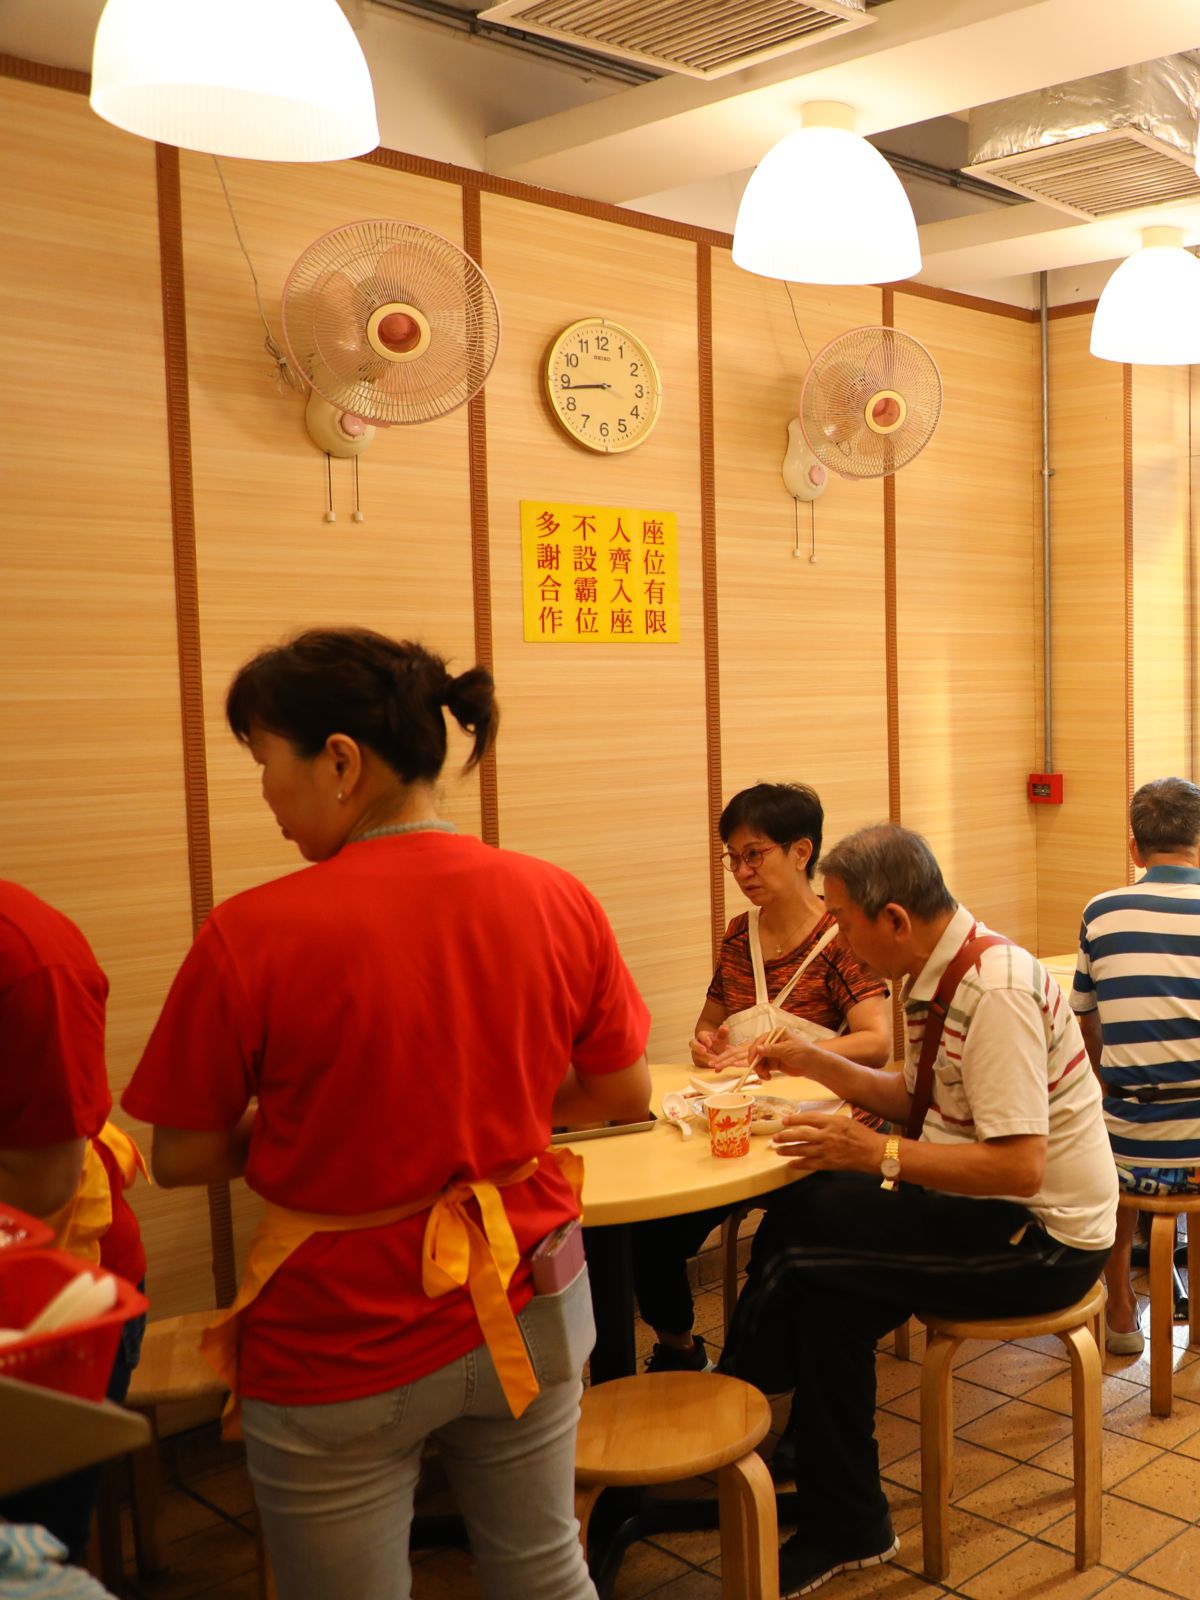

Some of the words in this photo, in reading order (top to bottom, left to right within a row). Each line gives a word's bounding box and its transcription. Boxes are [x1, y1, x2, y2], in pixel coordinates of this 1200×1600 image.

[578, 338, 589, 354] 11
[595, 335, 609, 351] 12
[564, 352, 579, 368] 10
[629, 362, 639, 377] 2
[560, 374, 571, 388] 9
[634, 384, 644, 399] 3
[566, 396, 576, 411] 8
[630, 405, 640, 419] 4
[581, 414, 590, 428] 7
[618, 418, 627, 433] 5
[600, 422, 609, 437] 6
[535, 511, 563, 634] 多謝合作
[572, 514, 599, 634] 不設霸位
[608, 517, 634, 635] 人齊入座
[642, 519, 668, 635] 座位有限
